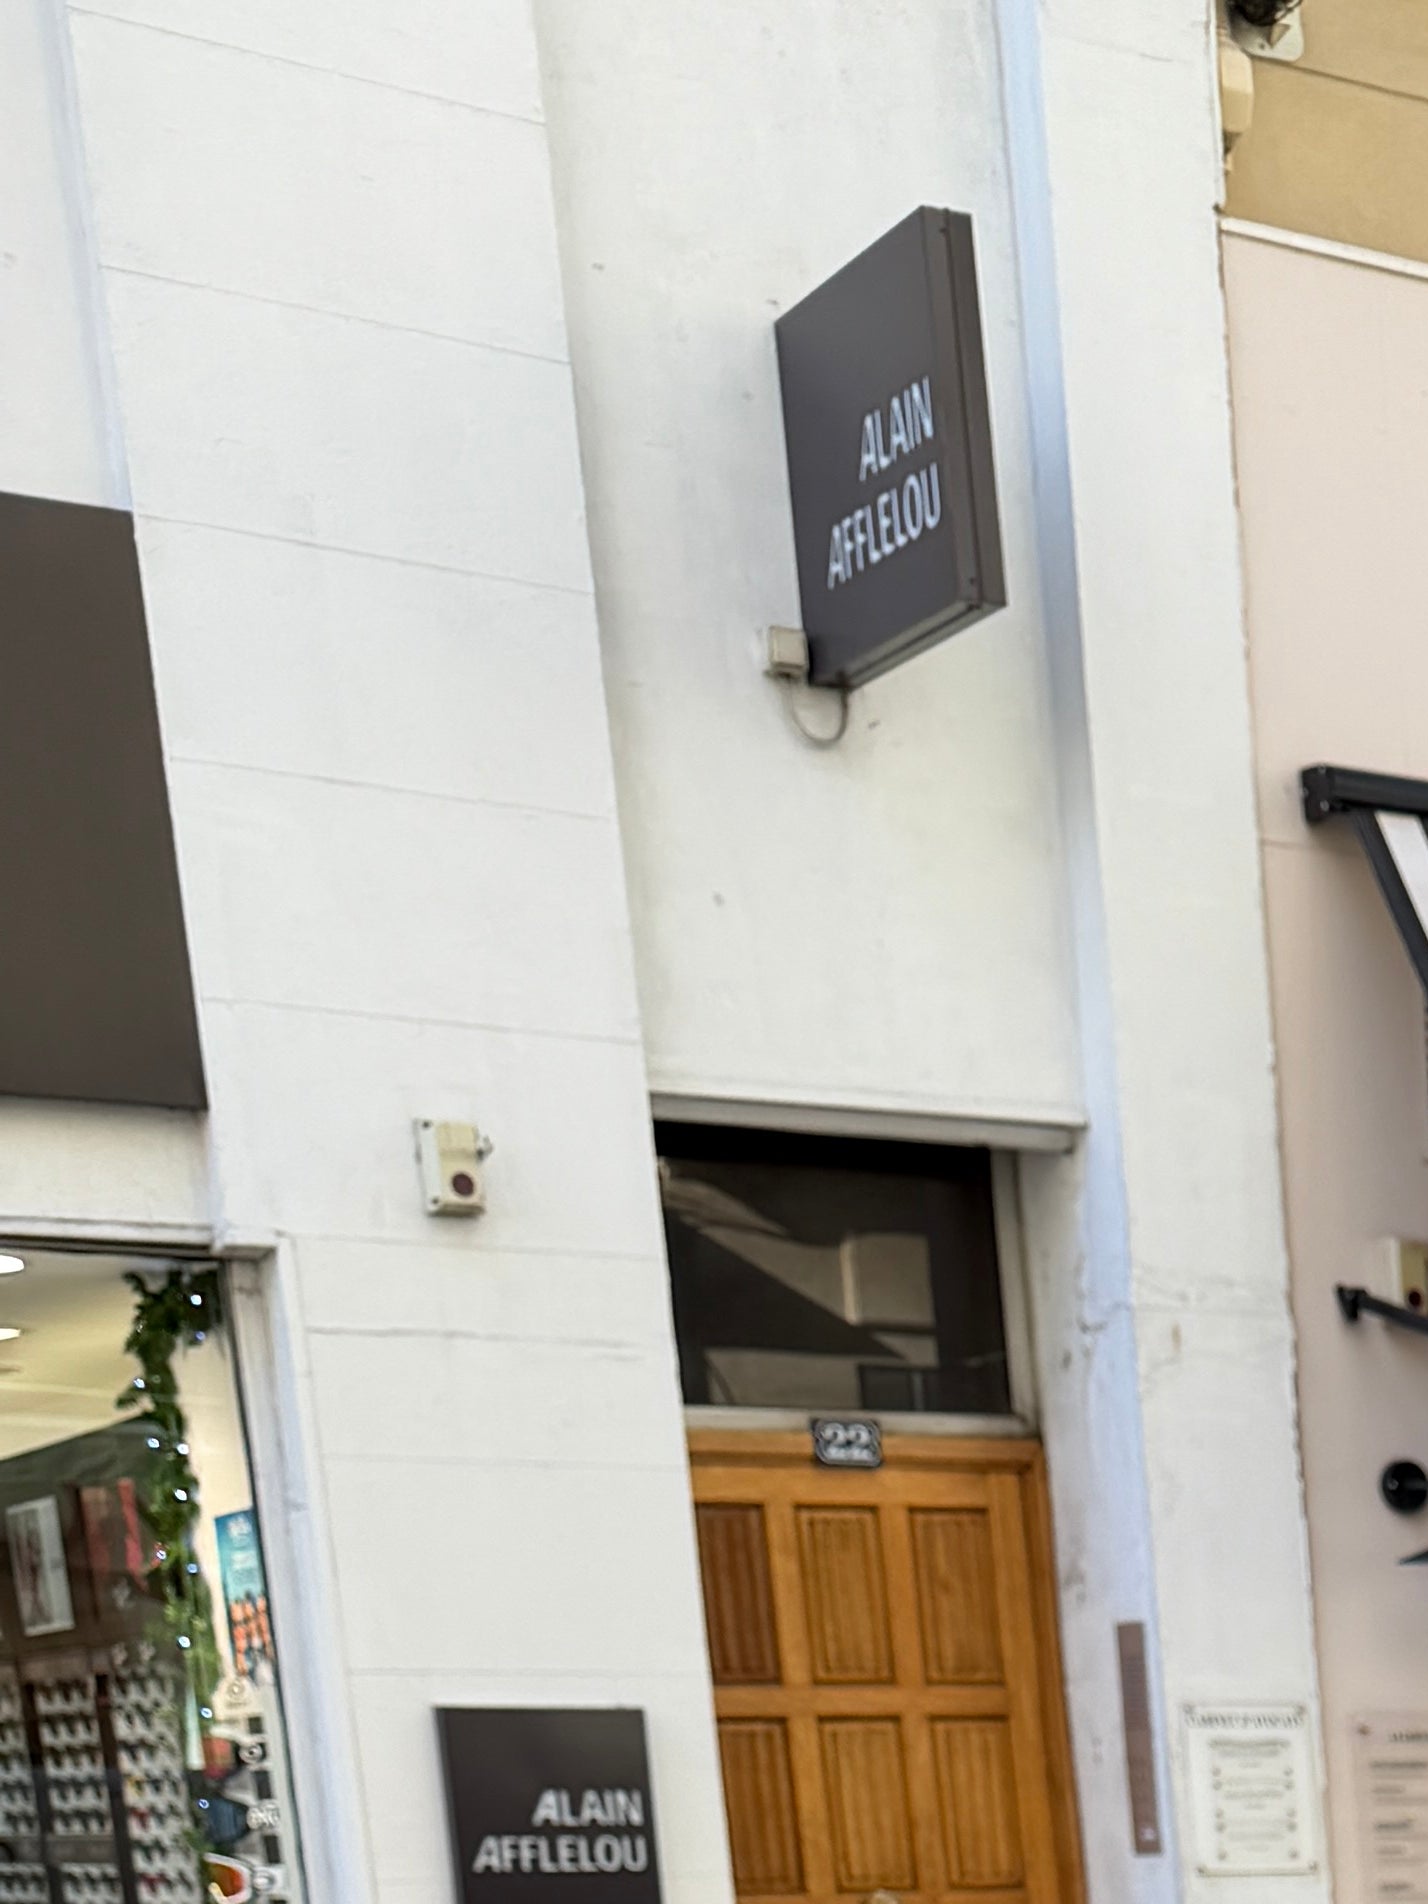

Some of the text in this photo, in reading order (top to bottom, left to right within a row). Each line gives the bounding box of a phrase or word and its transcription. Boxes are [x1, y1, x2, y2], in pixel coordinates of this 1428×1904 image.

[858, 376, 934, 482] ALAIN
[827, 462, 942, 590] AFFLELOU
[822, 1422, 873, 1460] 22
[531, 1788, 644, 1827] ALAIN
[472, 1834, 648, 1874] AFFLELOU
